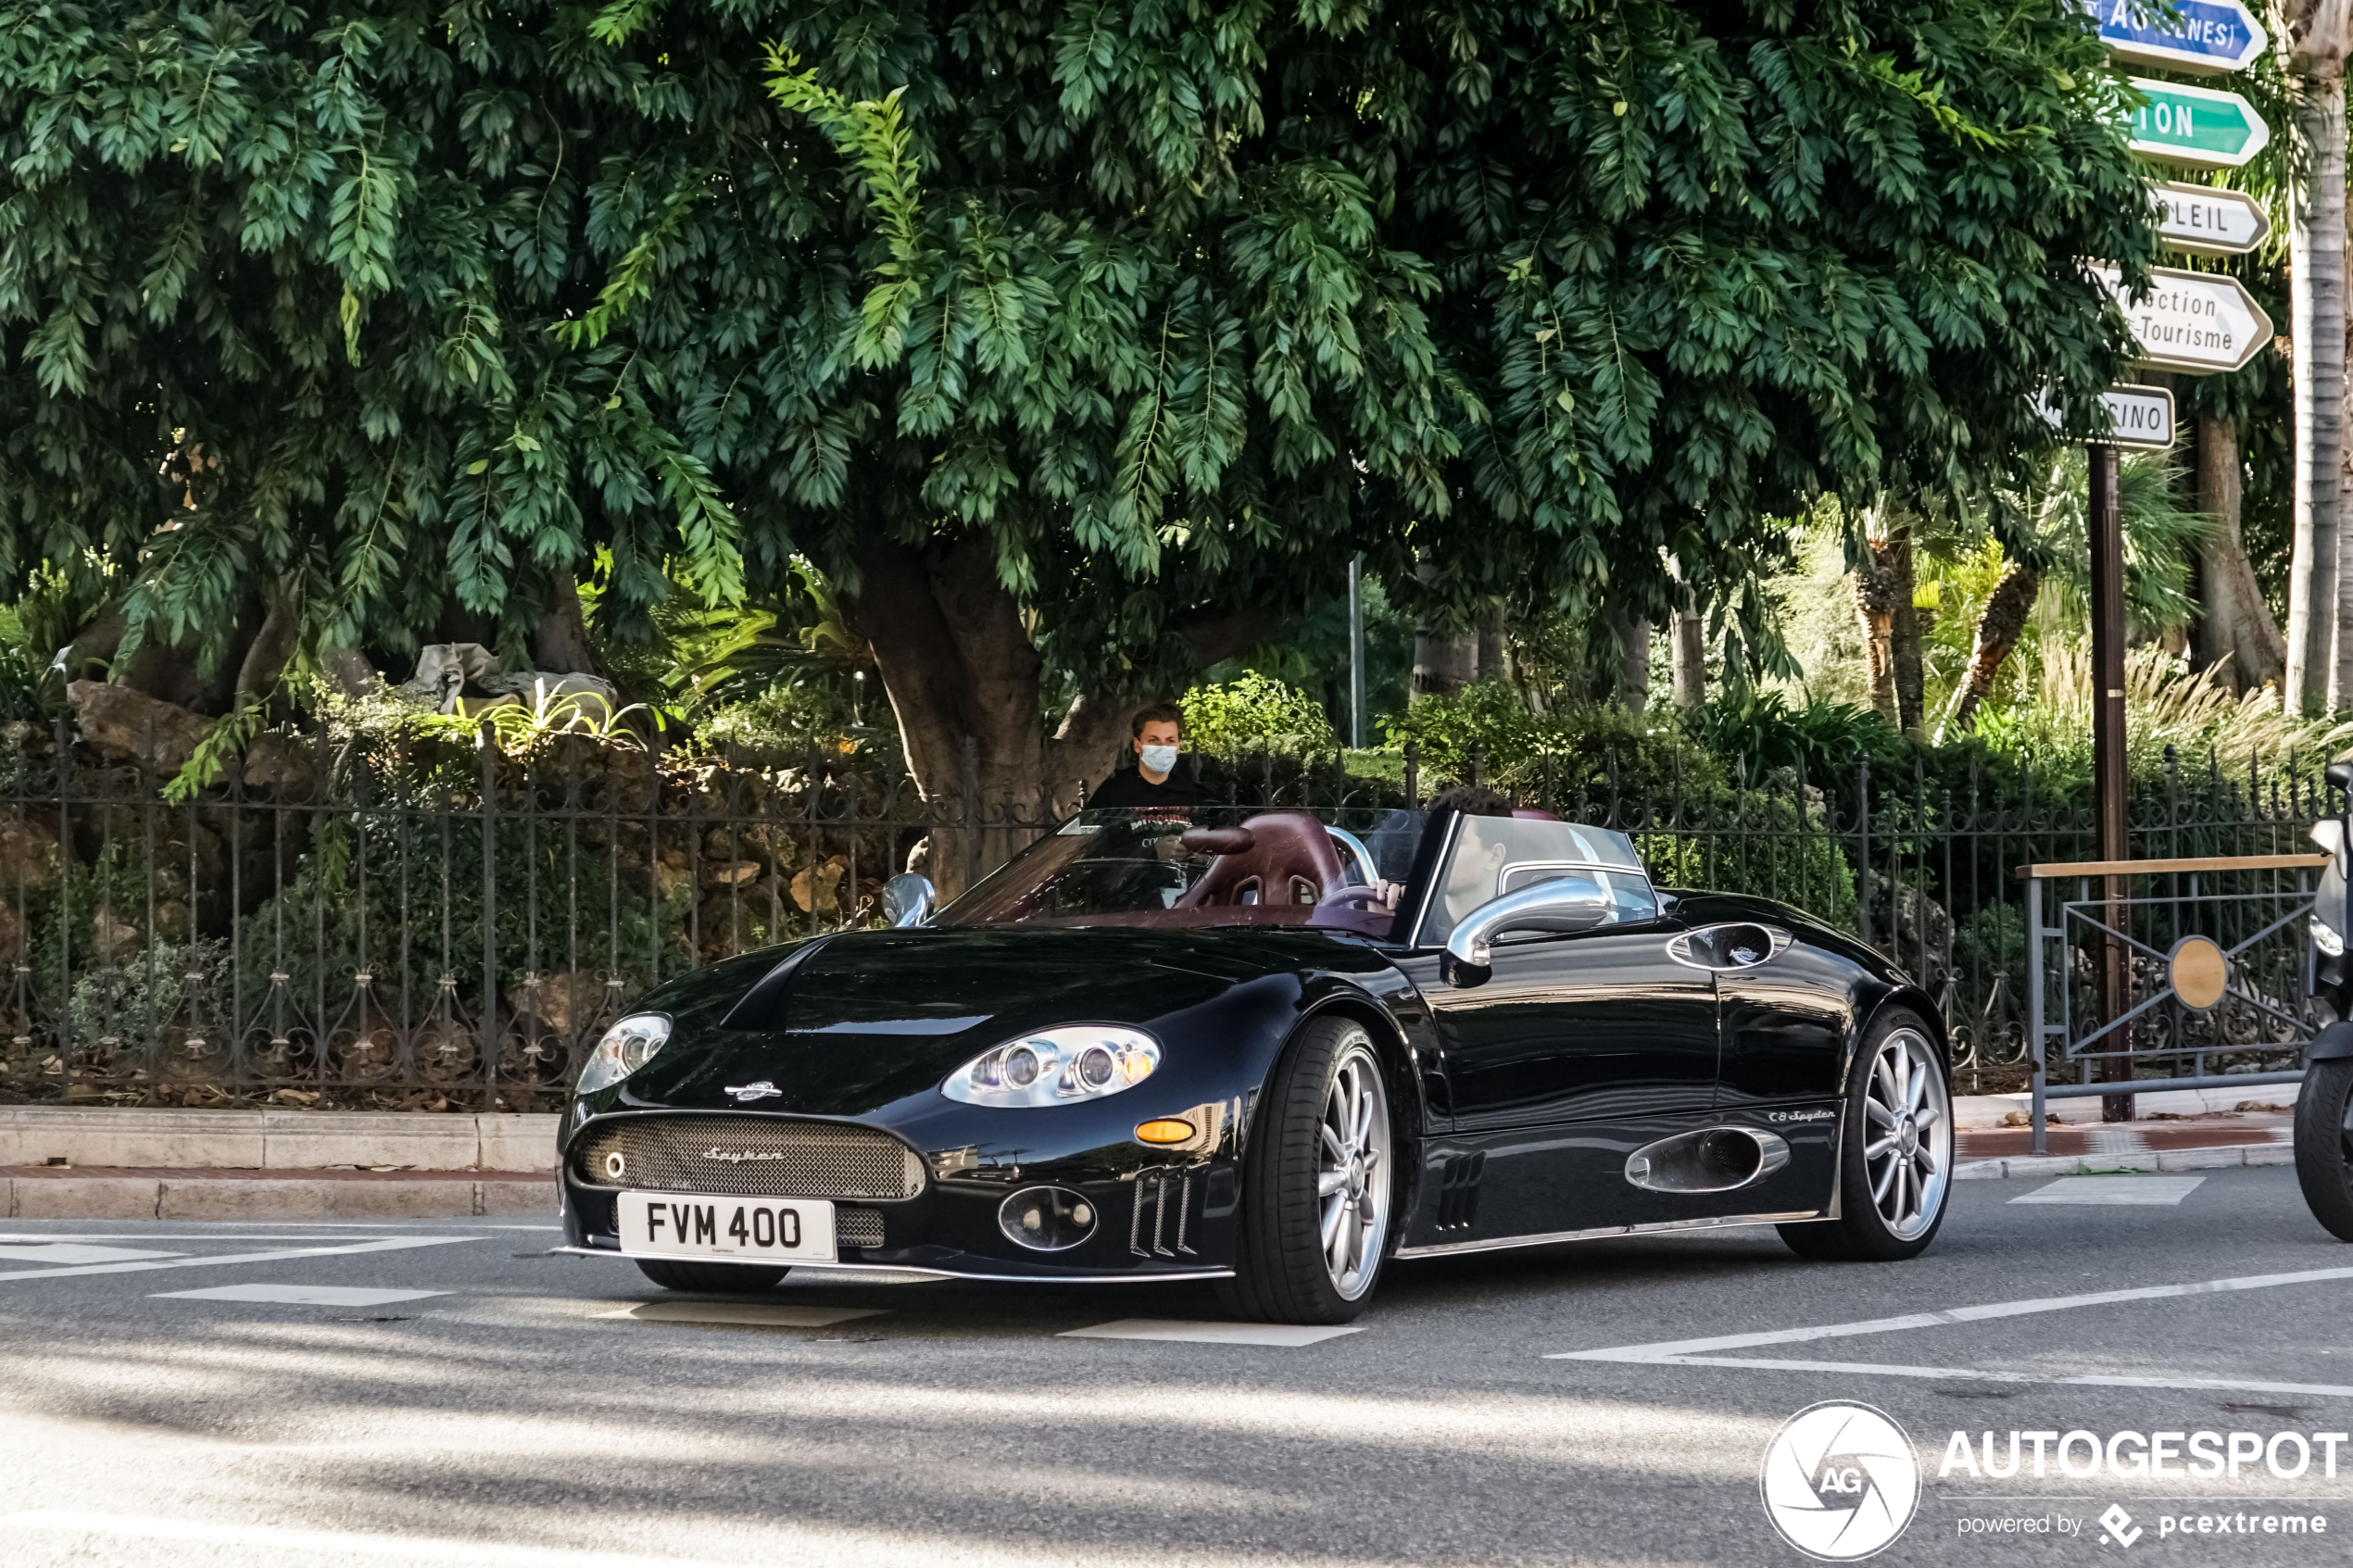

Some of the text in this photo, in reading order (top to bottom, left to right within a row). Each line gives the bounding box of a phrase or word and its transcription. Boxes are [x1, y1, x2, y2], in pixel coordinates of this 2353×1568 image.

[2141, 316, 2233, 350] Tourisme
[1768, 1110, 1836, 1123] C8 Spyder
[702, 1148, 786, 1164] Spyker
[648, 1202, 802, 1249] FVM 400
